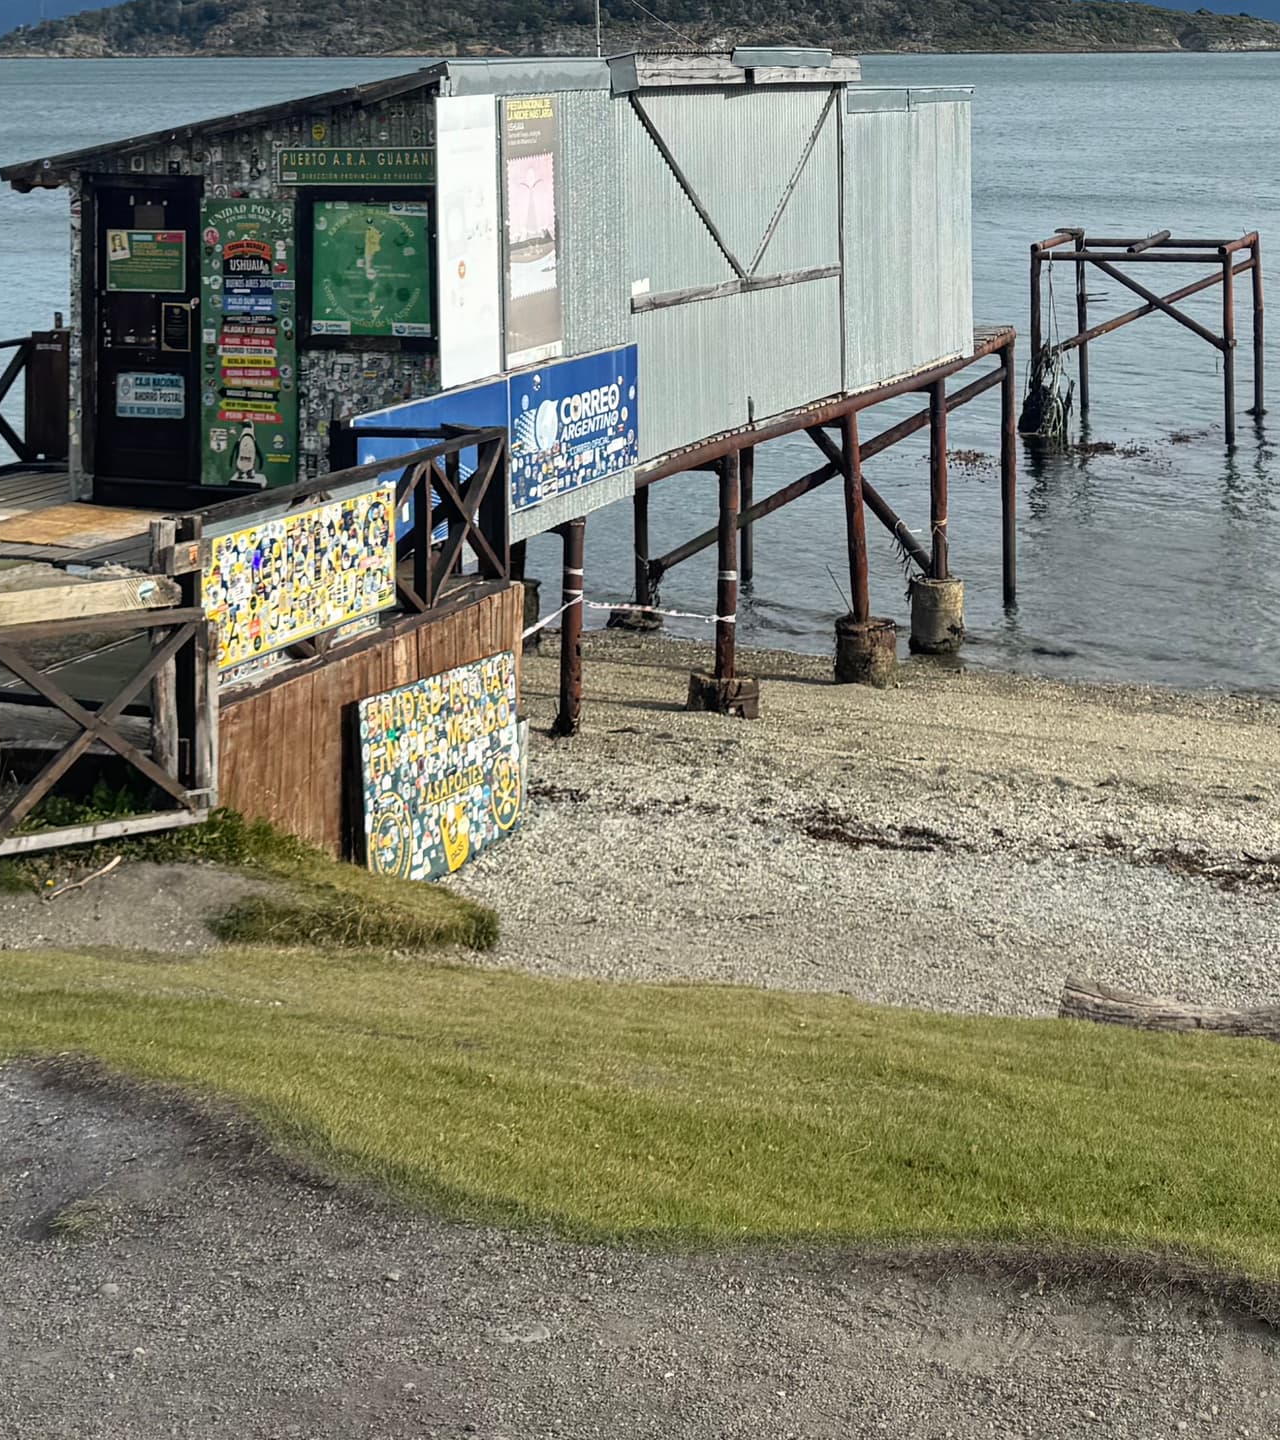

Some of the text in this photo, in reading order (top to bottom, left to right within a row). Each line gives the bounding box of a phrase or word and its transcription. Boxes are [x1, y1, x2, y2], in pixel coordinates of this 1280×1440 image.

[282, 152, 327, 166] PUERTO
[333, 152, 371, 166] A.R.A.
[208, 204, 289, 227] UNIDAD POSTAL
[230, 259, 263, 272] USHUAIA
[226, 279, 245, 288] BUENOS
[245, 279, 259, 288] AIRES
[223, 325, 246, 333] ALASKA
[135, 376, 182, 388] CAJA NACIONAL
[134, 391, 182, 403] AHORRO POSTAL
[560, 383, 620, 425] CORREO
[560, 410, 619, 443] ARGENTINO
[570, 435, 611, 456] CORREO OFICIAL
[418, 764, 484, 804] PASAPORTES
